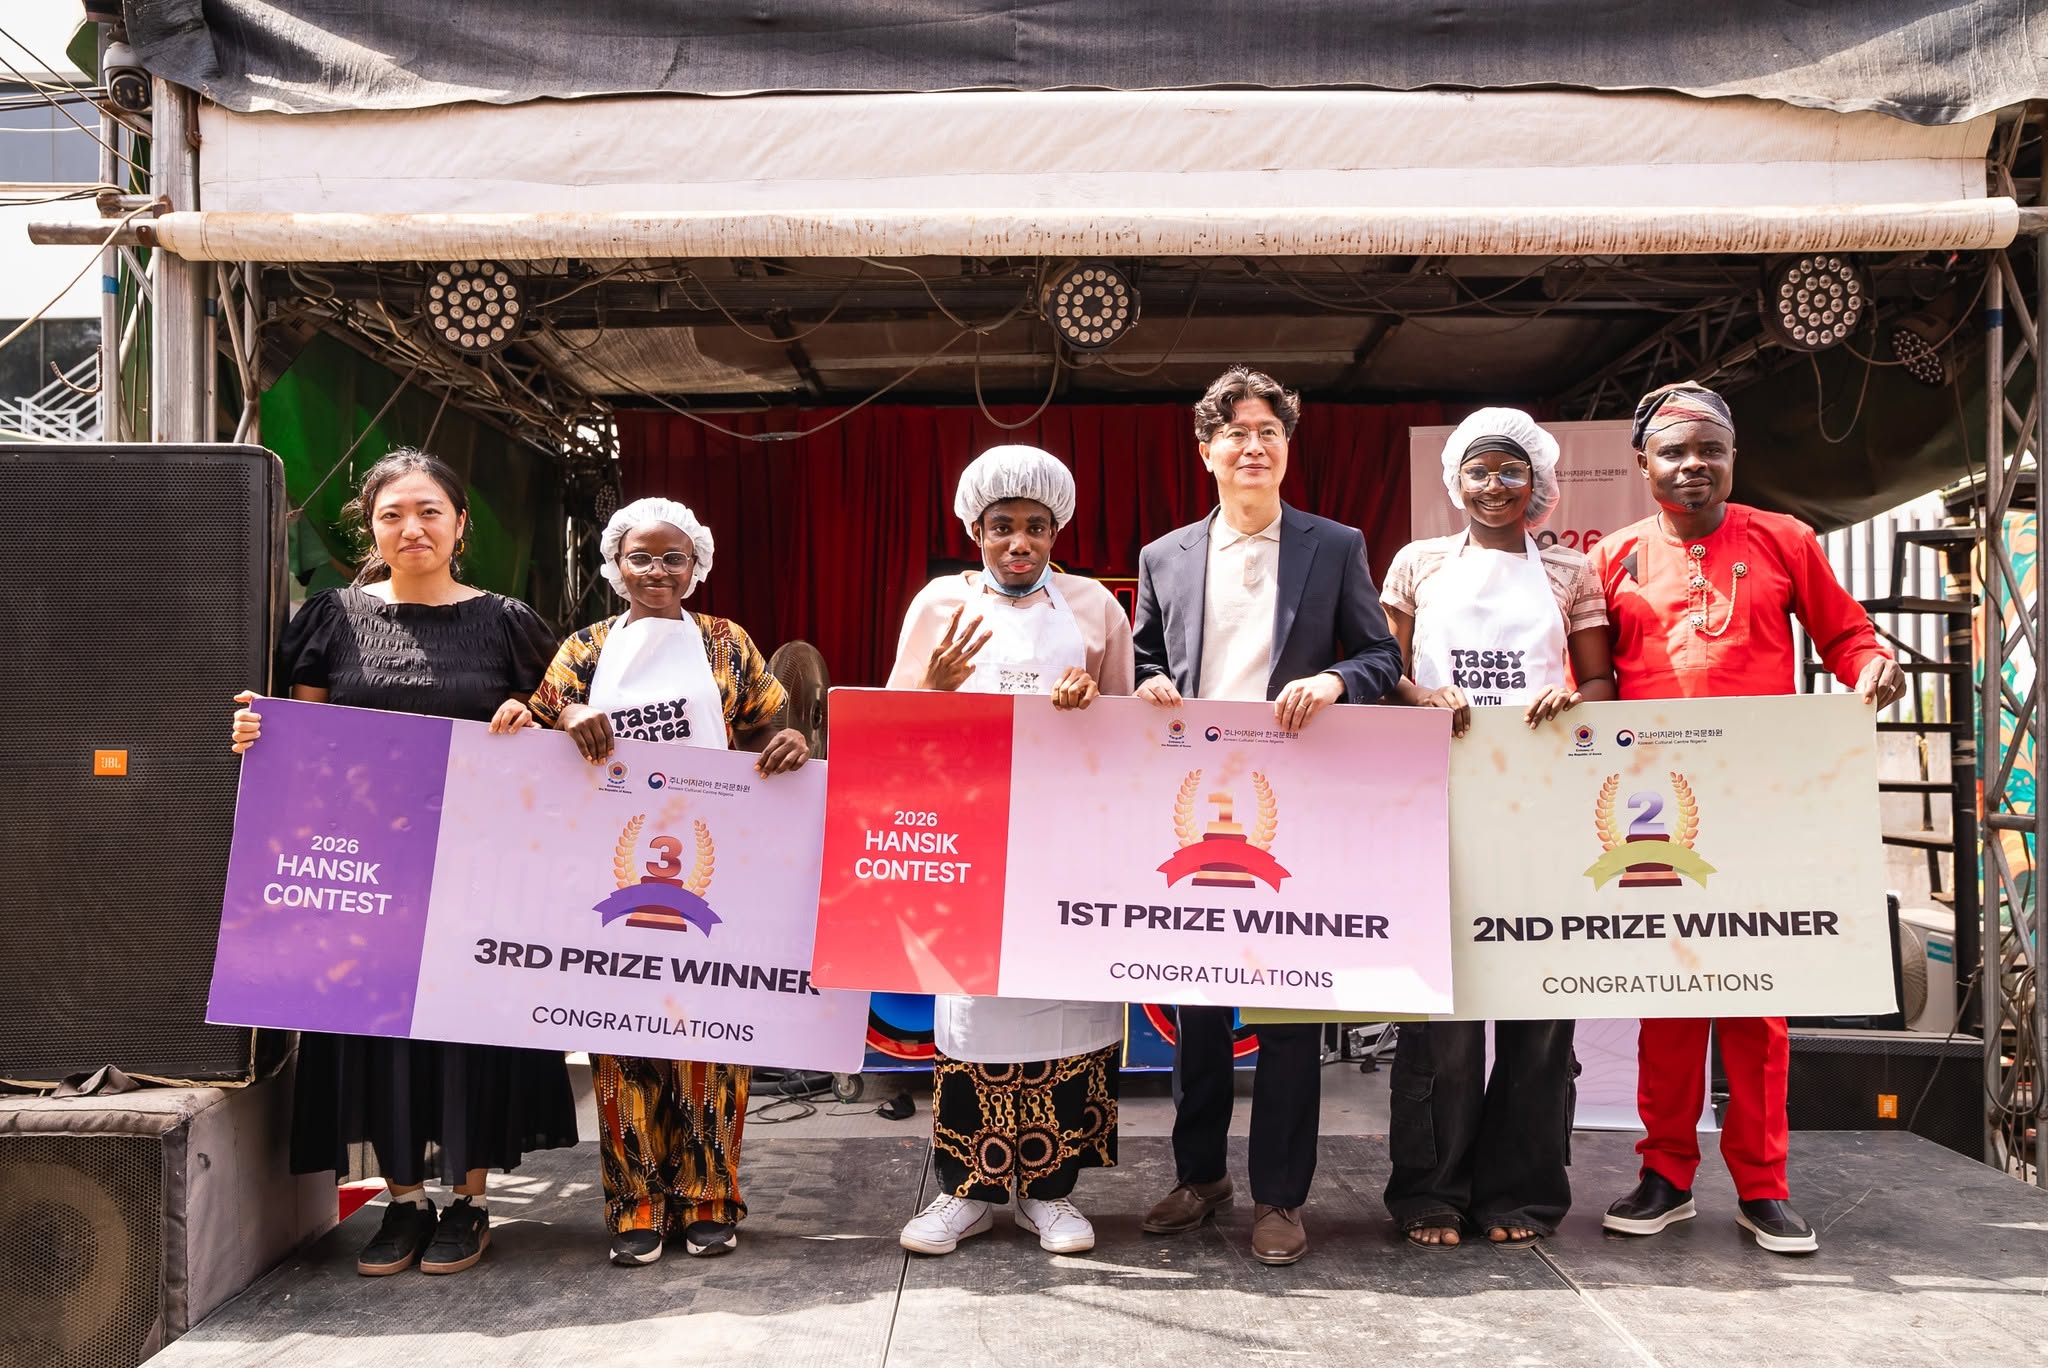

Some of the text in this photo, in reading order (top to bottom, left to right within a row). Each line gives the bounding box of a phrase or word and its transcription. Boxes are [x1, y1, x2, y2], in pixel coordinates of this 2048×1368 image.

[1224, 729, 1264, 738] 주나이지리아
[1638, 728, 1723, 739] 주나이지리아 한국문화원
[100, 756, 122, 768] JBL
[668, 776, 751, 793] 주나이지리아 한국문화원
[894, 810, 938, 827] 2026
[1626, 792, 1664, 835] 2
[311, 835, 360, 854] 2026
[865, 830, 959, 854] HANSIK
[276, 854, 381, 885] HANSIK
[646, 836, 684, 878] 3
[854, 858, 972, 884] CONTEST
[263, 882, 392, 916] CONTEST
[1057, 900, 1390, 940] 1ST PRIZE WINNER
[1472, 910, 1840, 942] 2ND PRIZE WINNER
[474, 938, 553, 970] 3RD
[560, 947, 664, 981] PRIZE
[1109, 962, 1334, 988] CONGRATULATIONS
[1542, 973, 1774, 994] CONGRATULATIONS
[532, 1006, 754, 1042] CONGRATULATIONS
